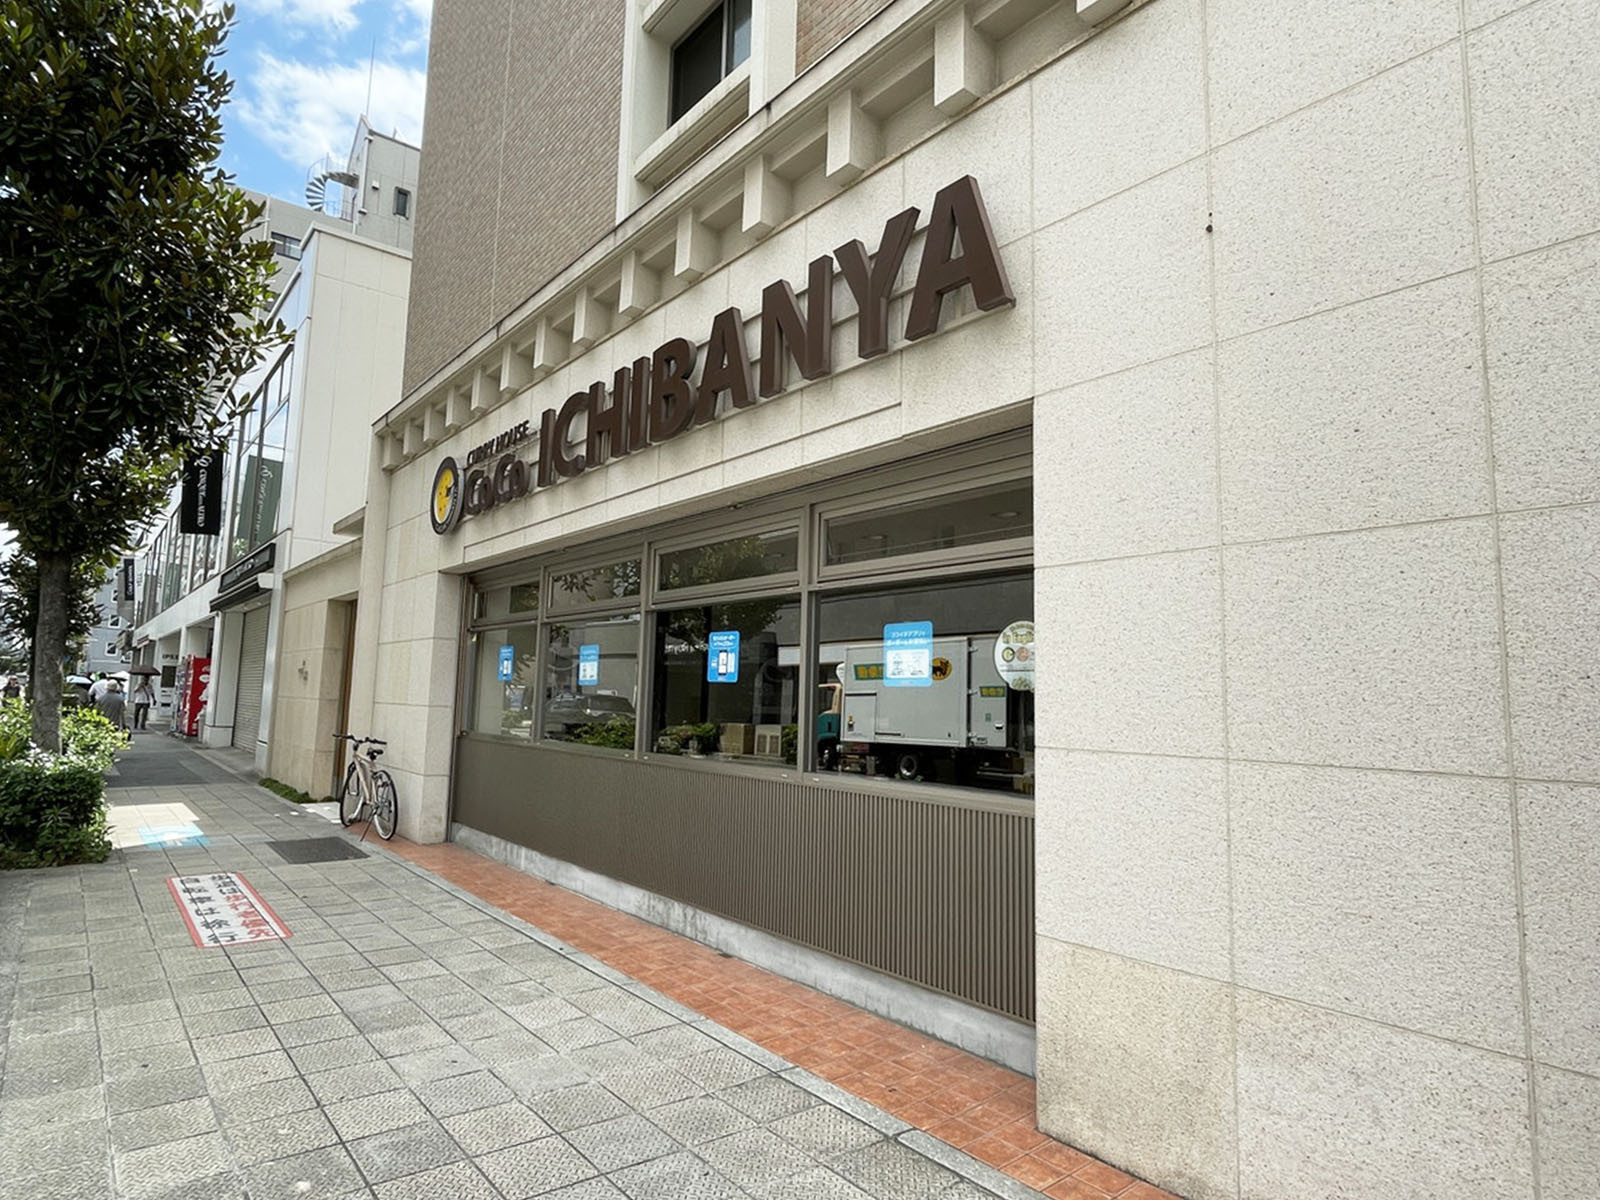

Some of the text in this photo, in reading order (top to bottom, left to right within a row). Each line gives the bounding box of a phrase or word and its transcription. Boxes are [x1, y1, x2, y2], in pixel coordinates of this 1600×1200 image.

[537, 174, 1016, 489] ICHIBANYA
[496, 419, 530, 454] HOUSE
[180, 877, 238, 944] 自転車は徐行
